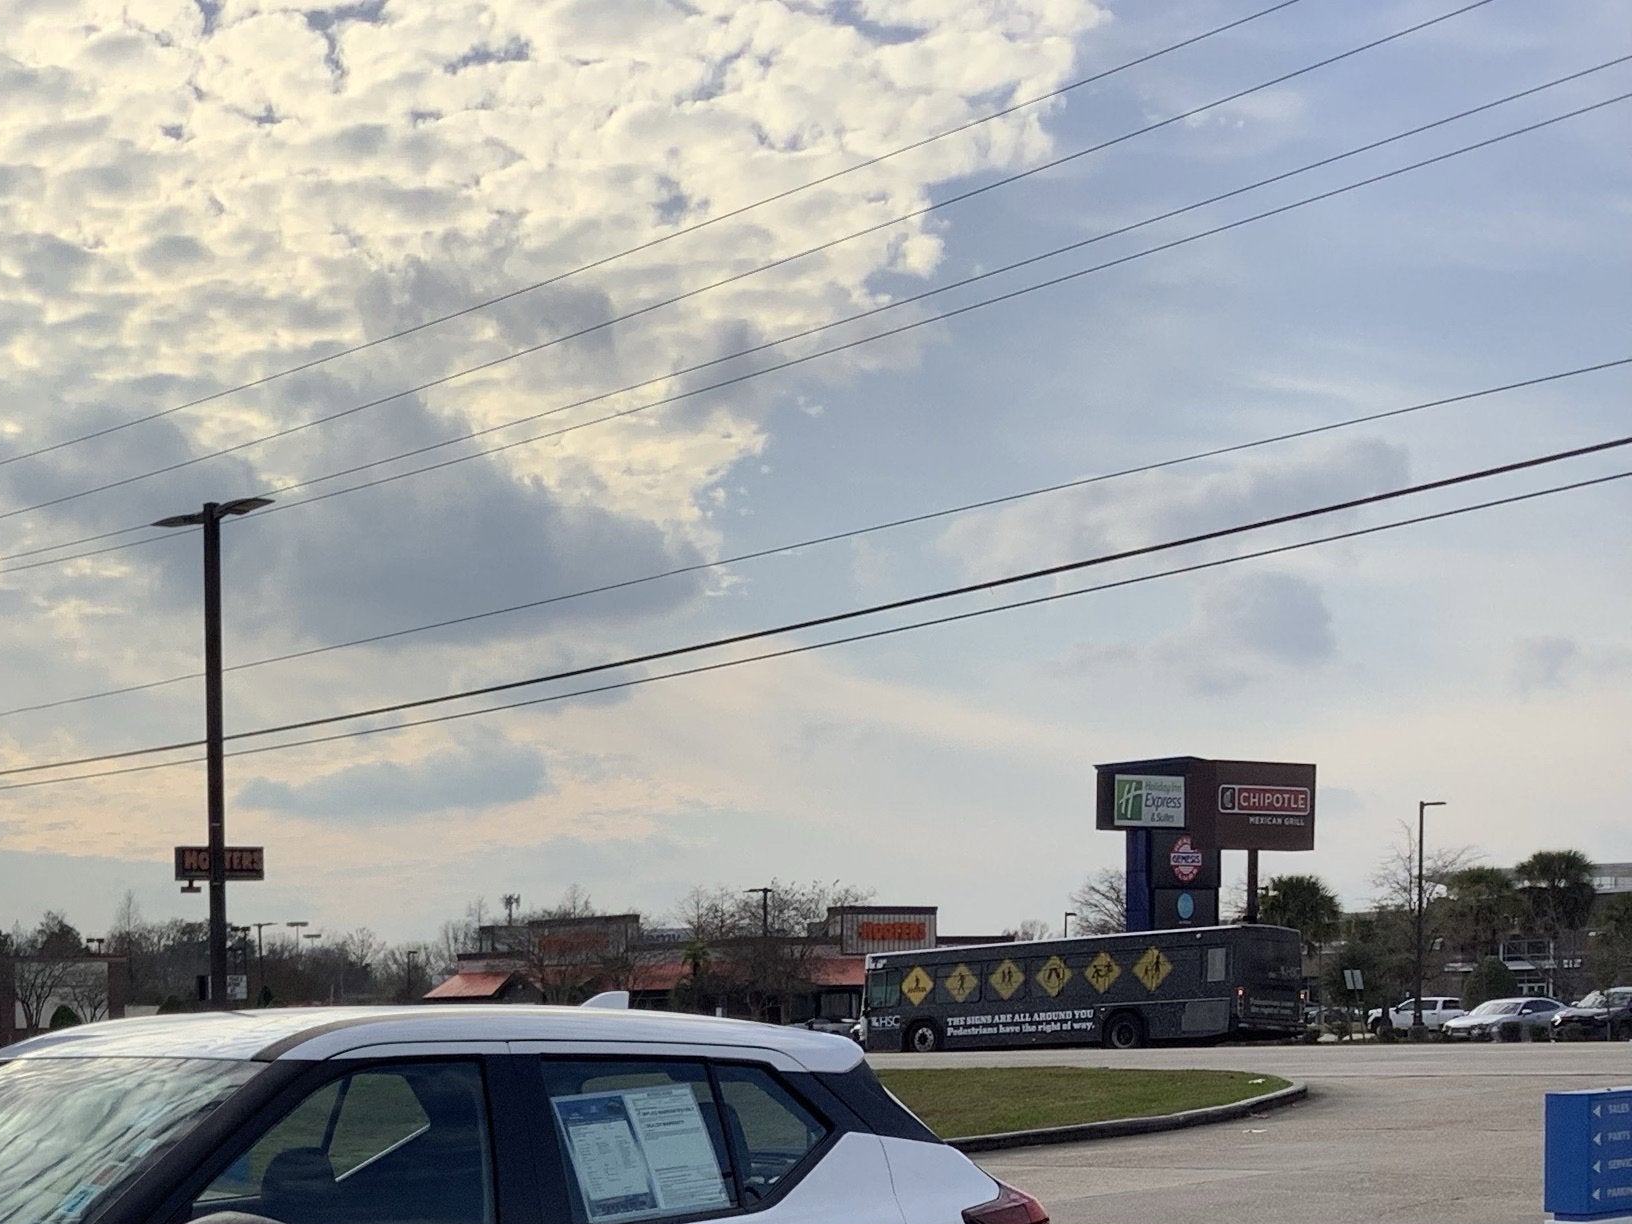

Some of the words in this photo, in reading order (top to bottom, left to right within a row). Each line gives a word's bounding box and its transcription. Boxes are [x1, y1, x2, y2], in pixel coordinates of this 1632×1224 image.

[1145, 793, 1182, 811] Express
[1240, 792, 1306, 808] CHIPOTLE
[1248, 816, 1282, 825] MEXICAN
[1284, 817, 1305, 826] GRILL
[183, 850, 263, 870] HOTERS
[1171, 855, 1200, 864] GENESIS
[947, 1017, 965, 1026] THE
[966, 1015, 992, 1025] SIGNS
[993, 1013, 1013, 1024] ARE
[1013, 1012, 1031, 1022] ALL
[1032, 1010, 1072, 1021] AROUND
[1074, 1009, 1094, 1019] YOU
[947, 1025, 997, 1036] Pedestrians
[998, 1024, 1020, 1034] have
[1022, 1023, 1037, 1032] the
[1038, 1021, 1061, 1033] right
[1062, 1021, 1071, 1030] of
[1608, 1103, 1629, 1113] SALES
[1608, 1131, 1631, 1141] PARTS
